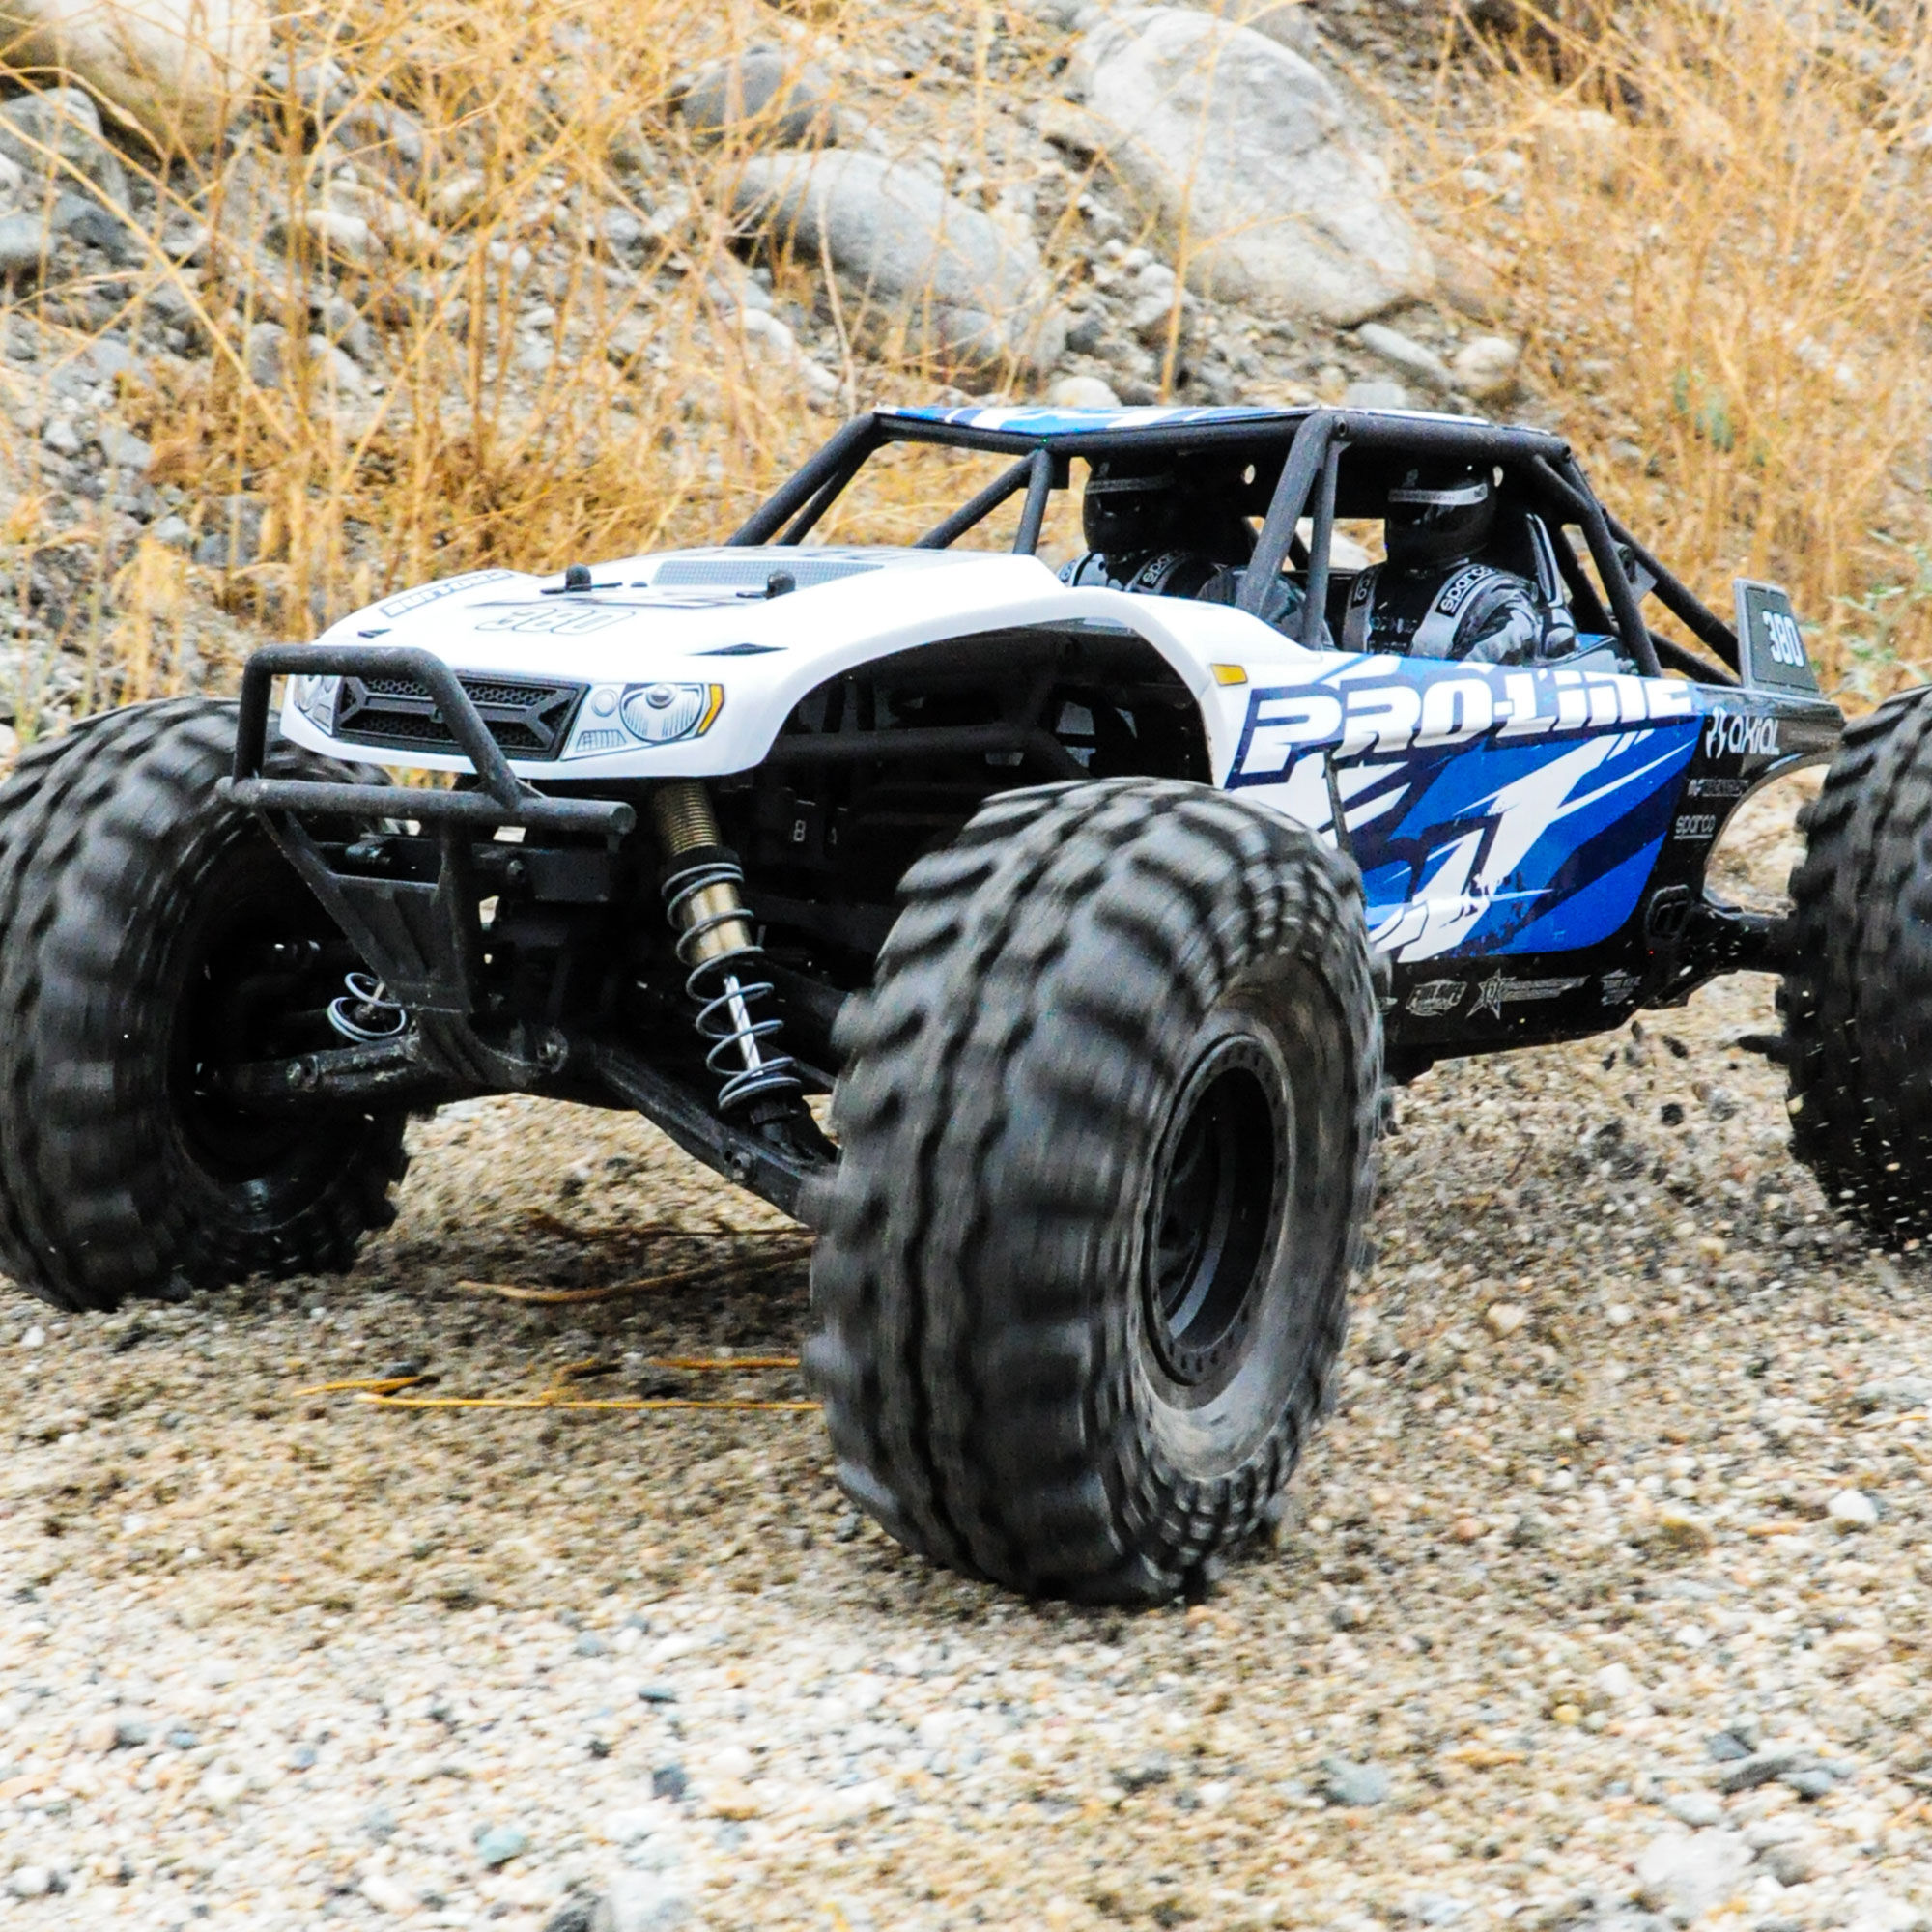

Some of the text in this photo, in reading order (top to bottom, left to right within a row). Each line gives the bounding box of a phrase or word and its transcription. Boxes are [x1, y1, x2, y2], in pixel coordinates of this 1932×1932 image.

[1440, 565, 1496, 613] sparco
[474, 608, 637, 635] 380
[1762, 610, 1804, 667] 380
[1674, 814, 1716, 839] sparco
